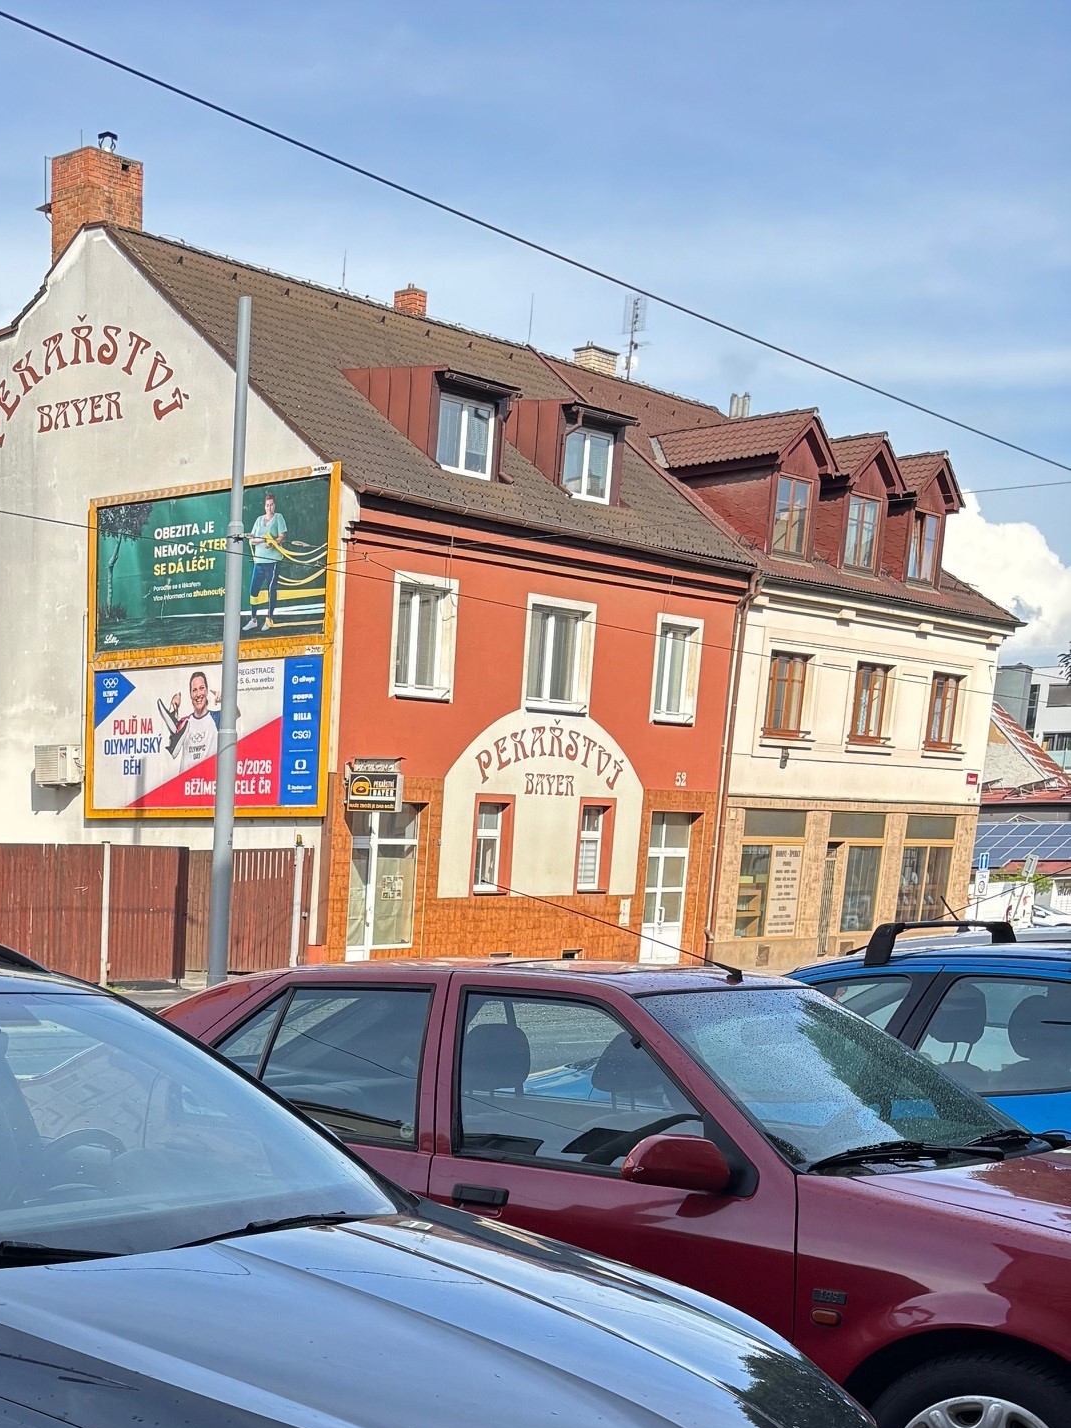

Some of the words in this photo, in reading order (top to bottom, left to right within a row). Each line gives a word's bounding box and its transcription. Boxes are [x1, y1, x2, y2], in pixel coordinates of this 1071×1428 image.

[37, 391, 123, 433] BAYER
[154, 523, 200, 540] OBEZITA
[201, 521, 215, 535] JE
[154, 541, 198, 558] NEMOC,
[199, 538, 227, 553] KTER
[153, 562, 167, 576] SE
[168, 557, 185, 574] DÁ
[186, 555, 216, 572] LÉČIT
[238, 667, 275, 675] REGISTRACE
[102, 690, 118, 698] OLYMPIC
[113, 715, 138, 735] POJĎ
[140, 718, 153, 735] NA
[293, 713, 312, 721] BILLA
[104, 733, 162, 755] OLYMPIJSKÝ
[189, 744, 206, 753] OLYMPIC
[123, 755, 141, 775] BĚH
[475, 719, 624, 791] PEKAŘSTVÍ
[184, 777, 217, 796] BĚŽÍME
[234, 776, 256, 795] CELÉ
[258, 776, 272, 795] ČR
[524, 772, 575, 797] BAYER
[675, 771, 687, 787] 52
